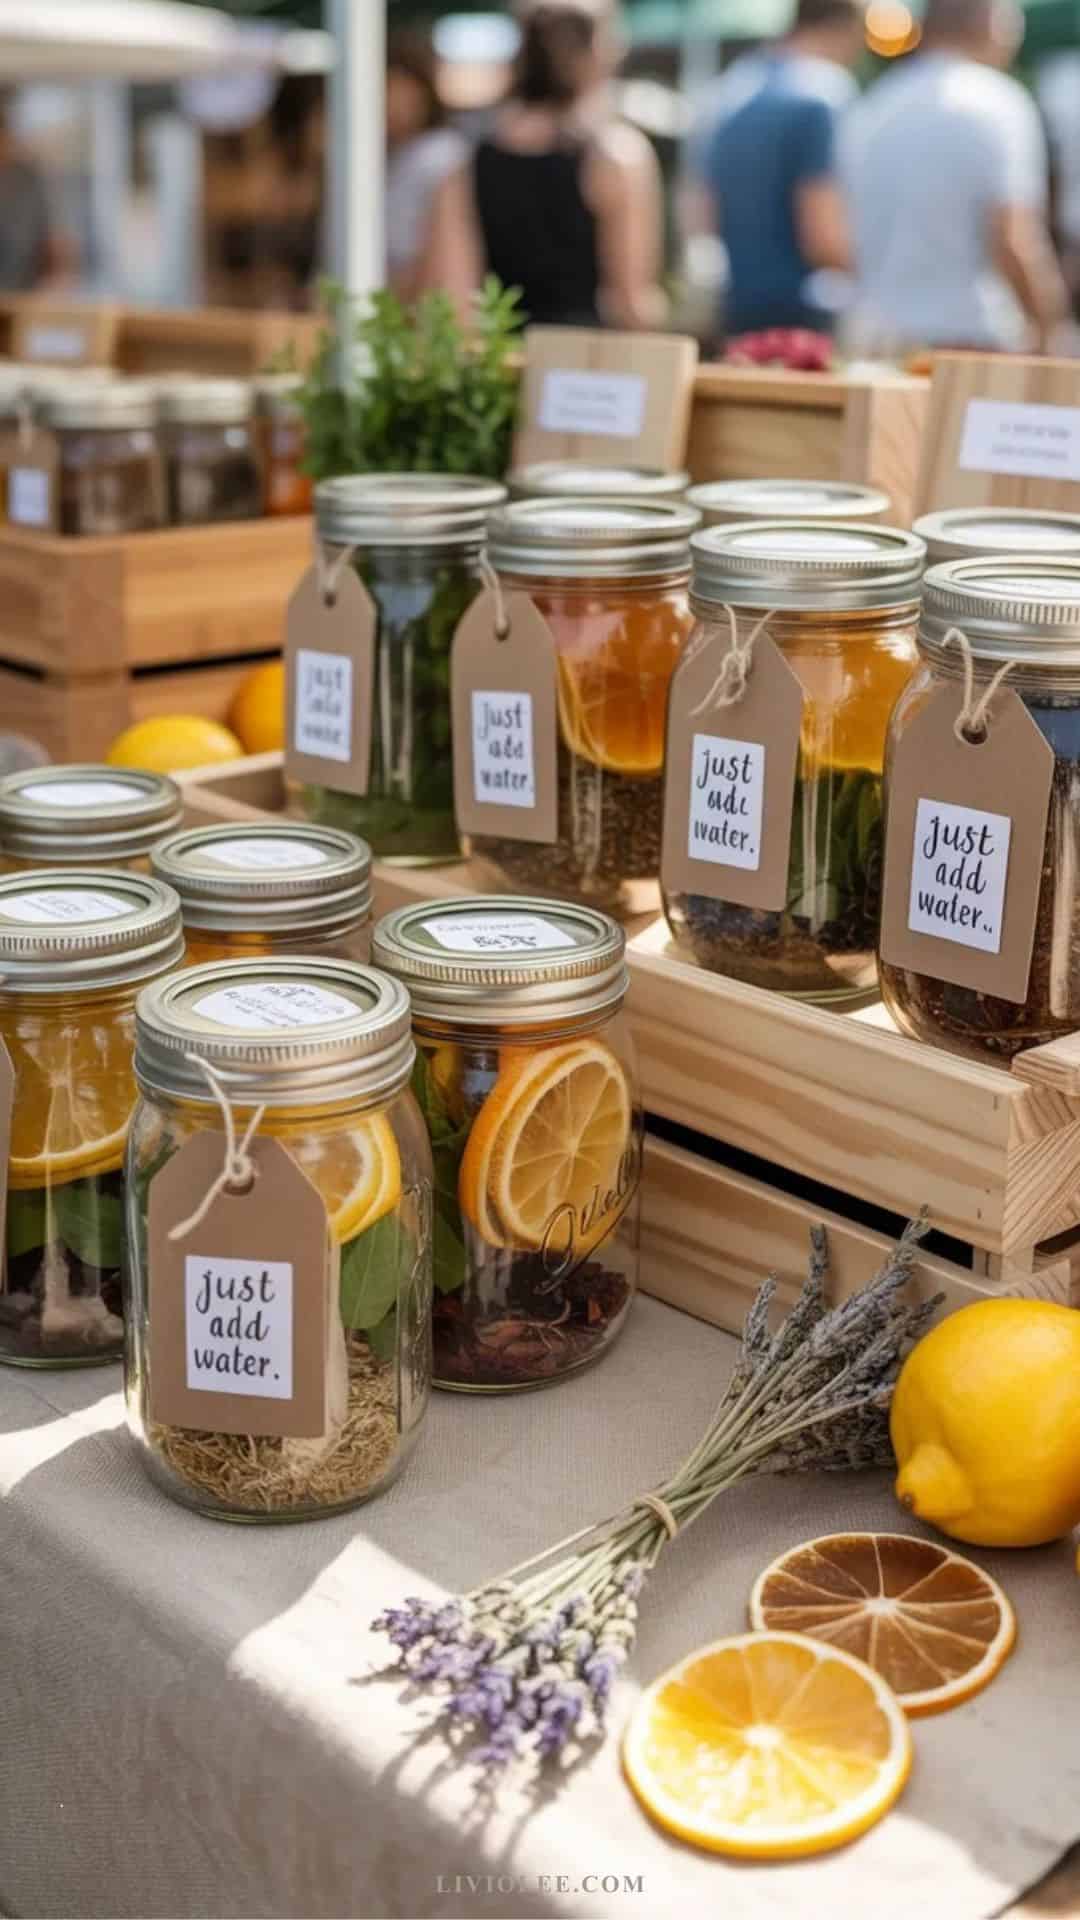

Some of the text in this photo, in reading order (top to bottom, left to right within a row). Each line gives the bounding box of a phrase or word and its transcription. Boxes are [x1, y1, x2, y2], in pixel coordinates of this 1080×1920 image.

[478, 700, 527, 742] just
[696, 749, 753, 789] just
[923, 816, 995, 860] just
[935, 856, 987, 895] add
[195, 1269, 276, 1315] just
[209, 1304, 270, 1342] add
[194, 1345, 280, 1381] water.
